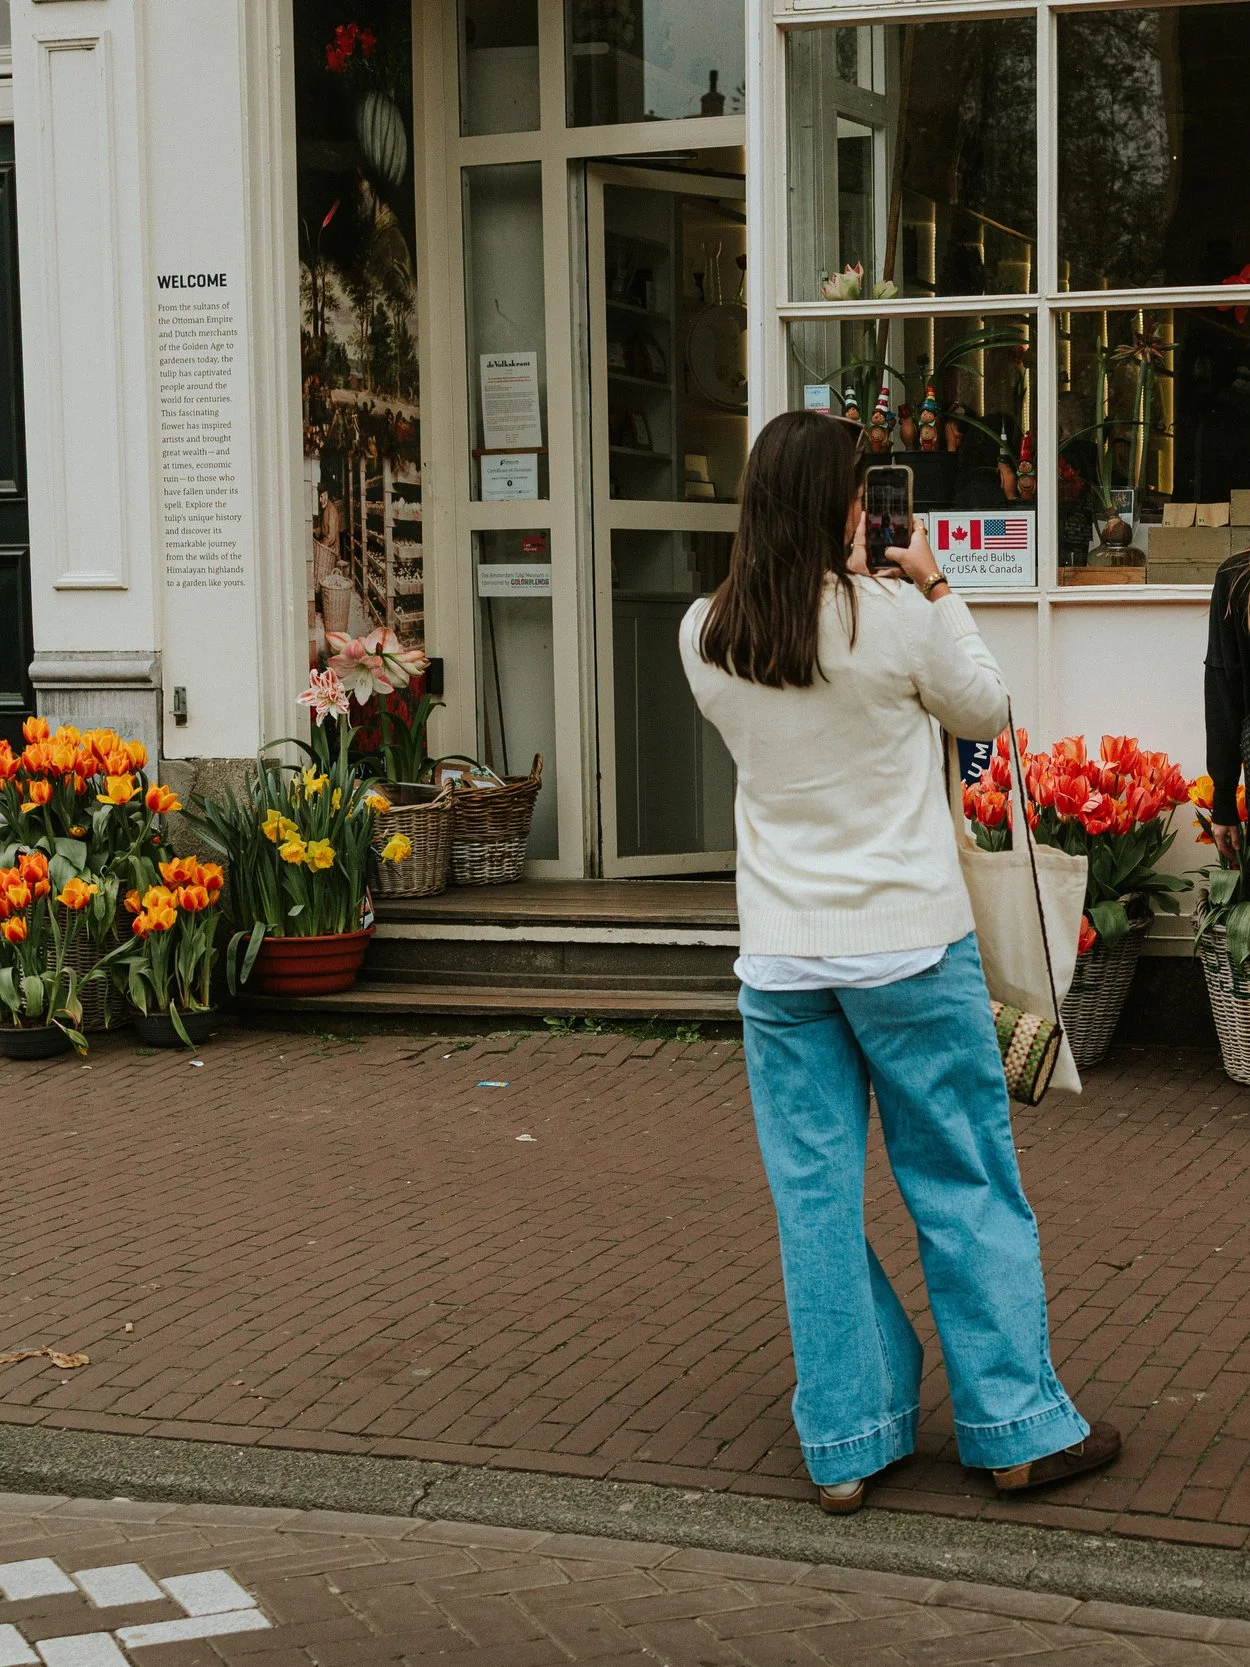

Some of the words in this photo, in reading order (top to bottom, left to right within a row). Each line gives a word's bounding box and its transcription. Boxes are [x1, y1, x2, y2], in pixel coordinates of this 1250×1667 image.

[157, 273, 227, 289] WELCOME
[158, 304, 178, 312] From
[193, 302, 220, 310] sultans
[207, 316, 233, 325] Empire
[211, 343, 224, 352] Age
[160, 357, 195, 366] gardeners
[197, 356, 220, 364] today,
[160, 370, 177, 378] tulip
[194, 369, 231, 378] captivated
[161, 384, 184, 392] people
[179, 409, 219, 417] fascinating
[187, 422, 199, 430] has
[202, 421, 232, 431] inspired
[203, 435, 231, 444] brought
[163, 449, 181, 458] great
[172, 462, 194, 470] times,
[164, 488, 181, 496] have
[165, 501, 183, 509] spell.
[185, 501, 212, 510] Explore
[188, 515, 214, 523] unique
[216, 514, 242, 523] history
[166, 540, 206, 548] remarkable
[208, 540, 236, 549] journey
[950, 553, 988, 562] Certified
[991, 553, 1015, 561] Bulbs
[167, 566, 205, 575] Himalayan
[208, 566, 244, 574] highlands
[943, 565, 955, 573] for
[958, 565, 977, 573] USA
[989, 564, 1022, 573] Canada
[182, 580, 206, 588] garden
